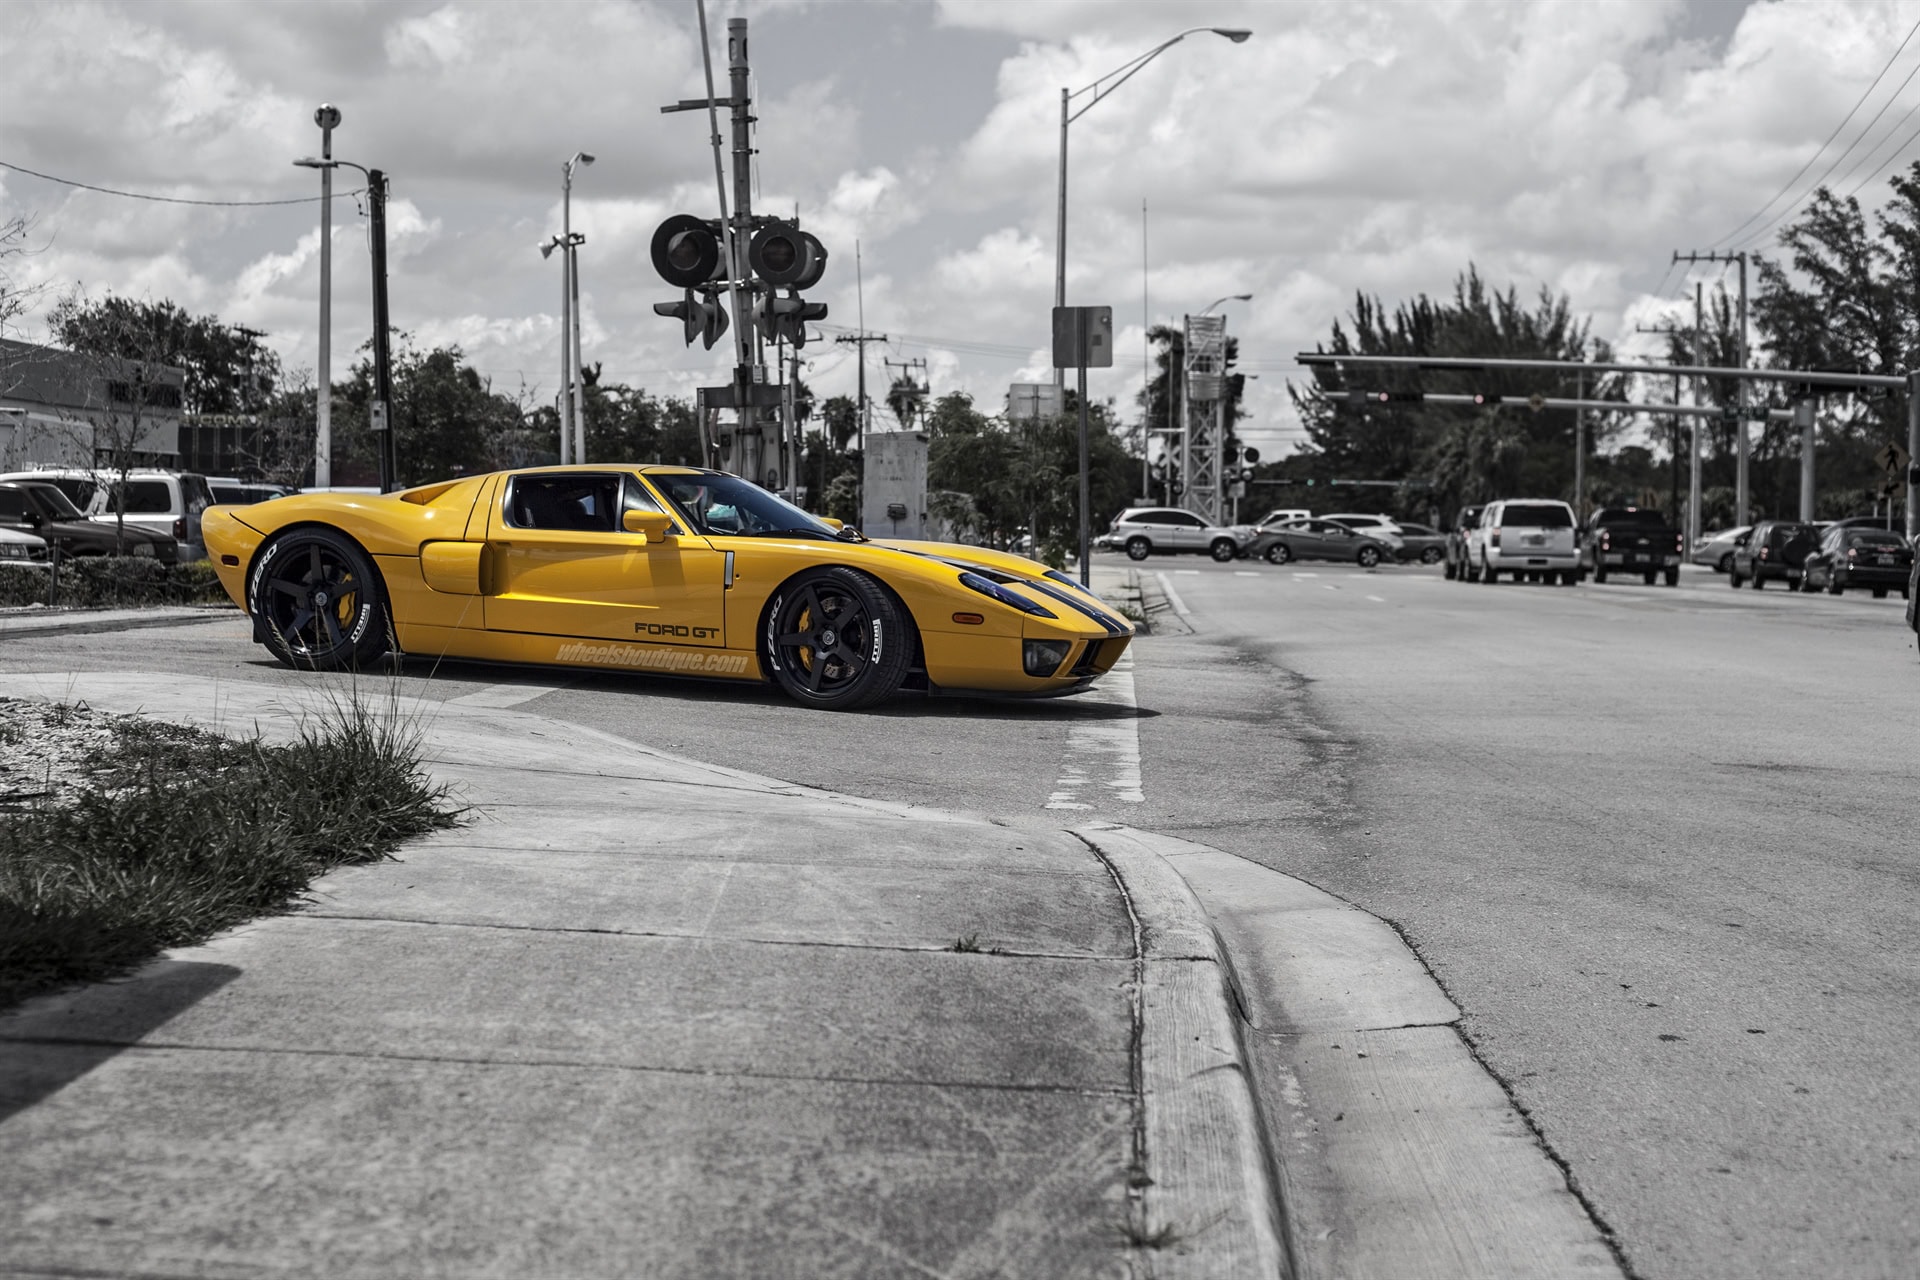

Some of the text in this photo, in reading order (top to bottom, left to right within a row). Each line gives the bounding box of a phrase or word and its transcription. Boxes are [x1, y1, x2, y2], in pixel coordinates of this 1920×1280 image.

[251, 543, 278, 597] ZERO
[634, 622, 720, 639] FORD GT
[767, 594, 783, 656] ZERO
[555, 642, 749, 673] wheelsboutique.com
